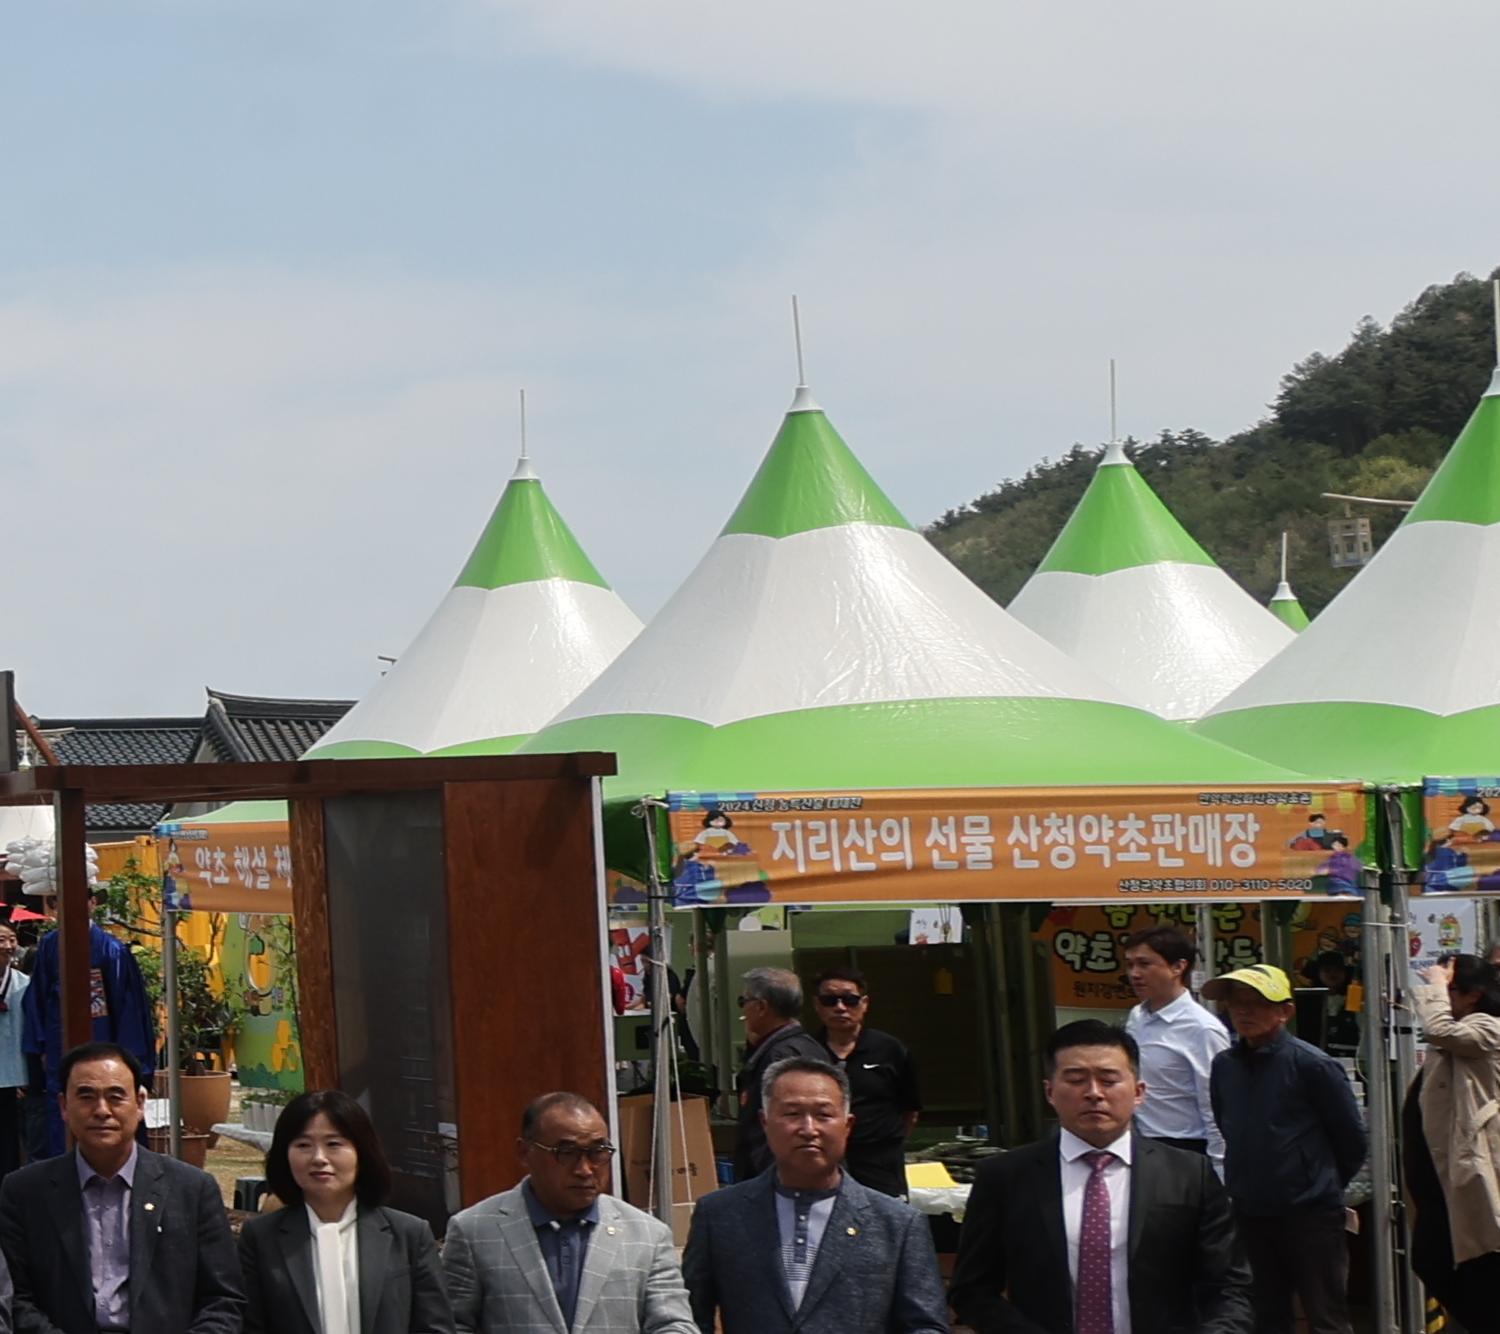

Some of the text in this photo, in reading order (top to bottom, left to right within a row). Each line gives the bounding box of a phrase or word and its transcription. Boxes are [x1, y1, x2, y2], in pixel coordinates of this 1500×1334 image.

[717, 796, 863, 812] 2024 산청 농특산물 대제전
[770, 812, 1261, 873] 지리산의 선물 산청약초판매장
[195, 846, 230, 889] 약초
[1210, 878, 1313, 891] 010-3110-5020
[1055, 931, 1117, 971] 약초
